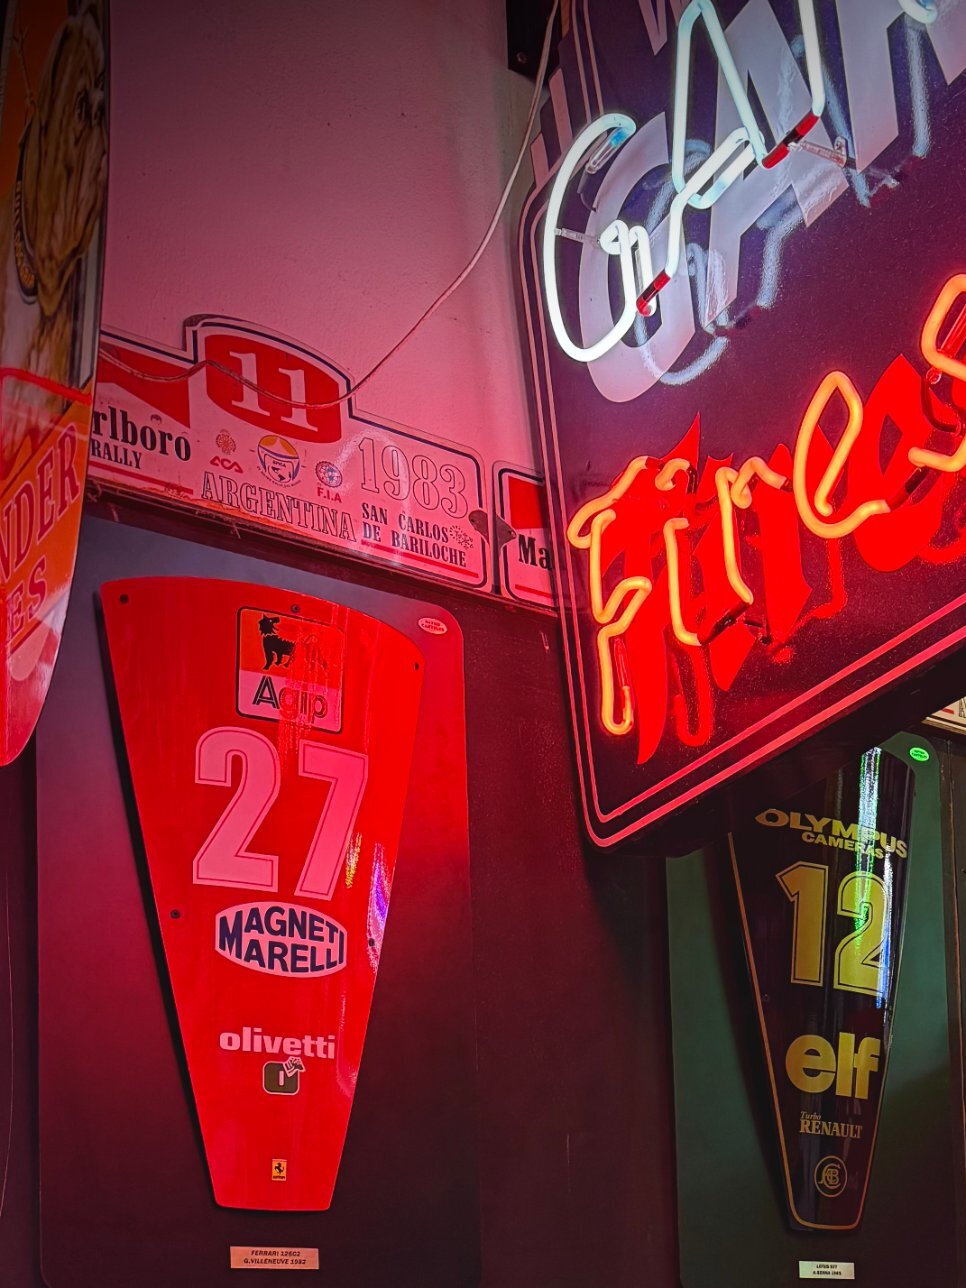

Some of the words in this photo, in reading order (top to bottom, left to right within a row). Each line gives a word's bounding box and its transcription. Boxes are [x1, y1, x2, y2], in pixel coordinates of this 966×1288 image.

[229, 351, 318, 432] 11
[91, 438, 142, 470] RALLY
[92, 405, 192, 463] rlboro
[358, 436, 469, 519] 1983
[201, 470, 357, 543] ARGENTINA
[361, 502, 388, 526] SAN
[398, 512, 449, 543] CARLOS
[362, 522, 381, 542] DE
[391, 533, 467, 568] BARILOCHE
[252, 675, 328, 724] Agip
[193, 726, 368, 901] 27
[755, 808, 909, 859] OLYMPUS
[801, 831, 886, 860] CAMERAS
[218, 905, 345, 945] MAGNETI
[775, 861, 890, 998] 12
[218, 935, 345, 974] MARELLI
[219, 1026, 336, 1060] olivetti
[785, 1032, 881, 1100] elf
[800, 1119, 863, 1140] RENAULT
